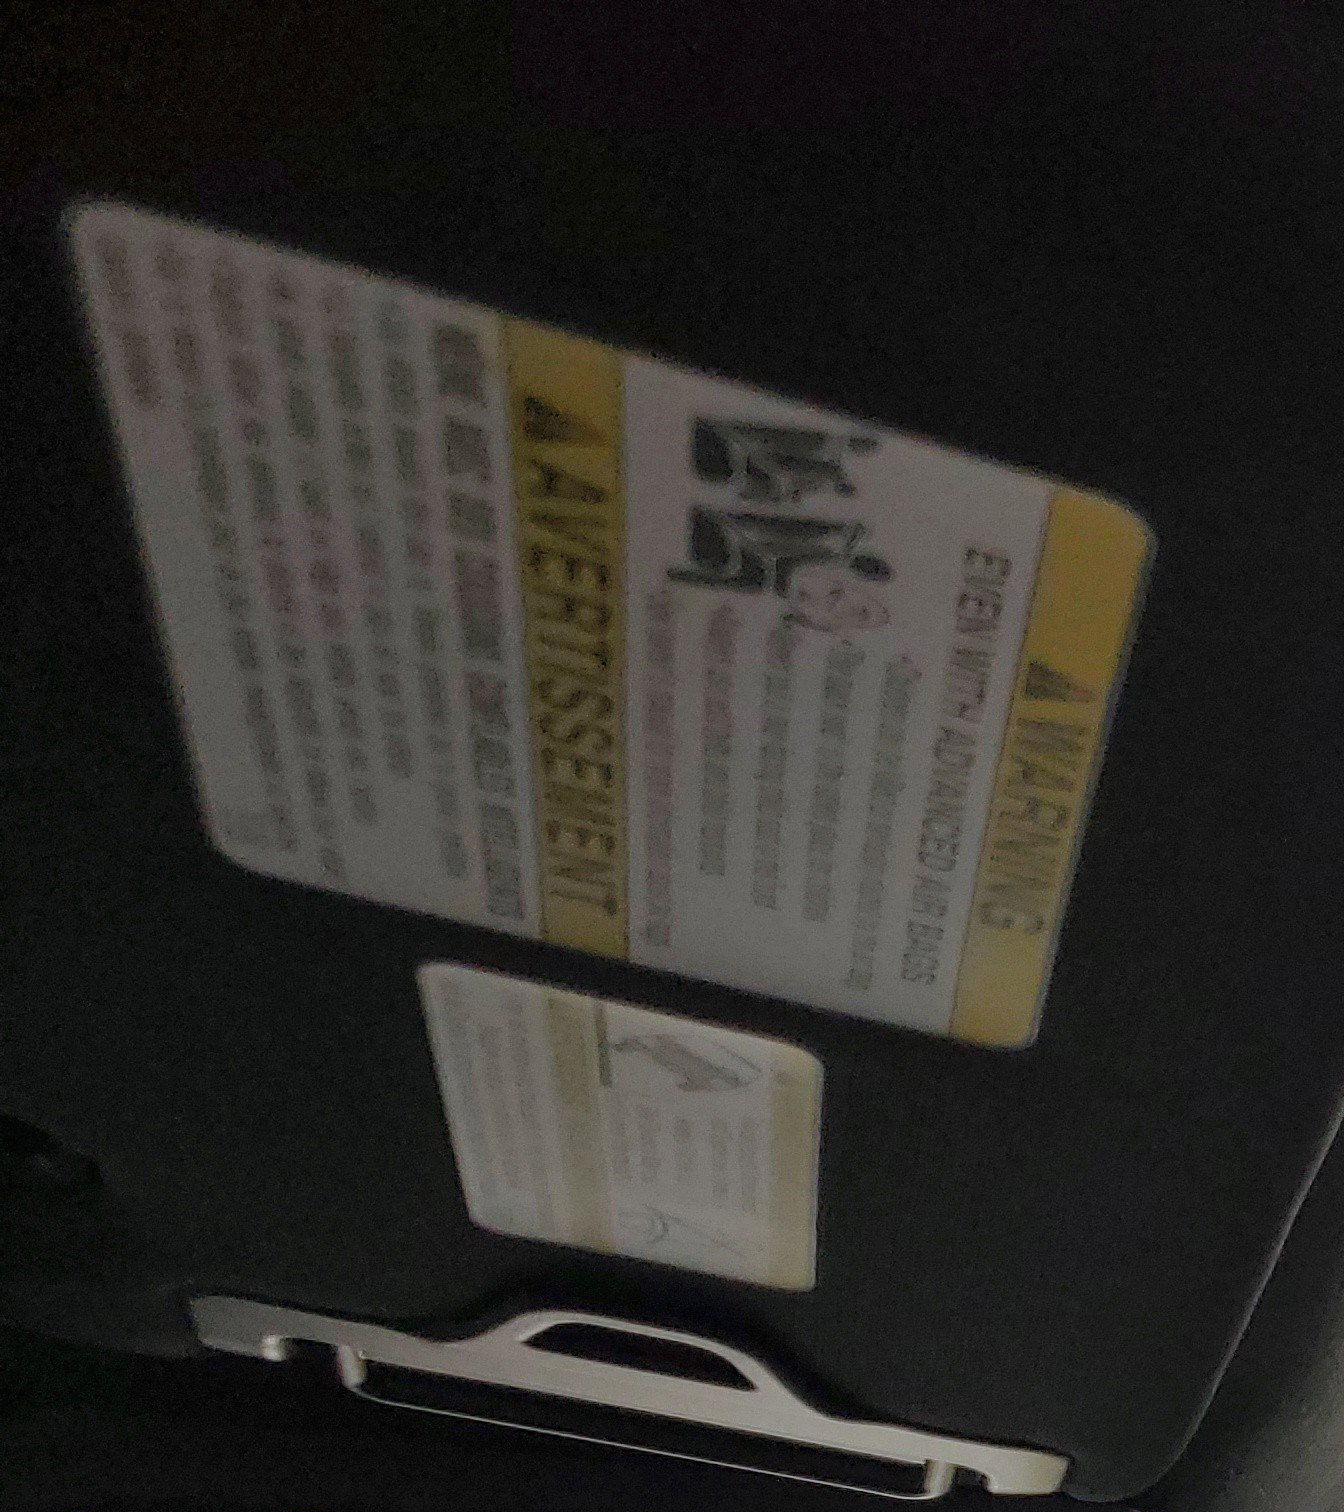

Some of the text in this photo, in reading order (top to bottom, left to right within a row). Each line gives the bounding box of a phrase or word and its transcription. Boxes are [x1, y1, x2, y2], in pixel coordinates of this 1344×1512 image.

[521, 454, 618, 919] AVERTISSEMENT
[898, 544, 1012, 987] EVEN WITH ADVANCED AIR BAGS
[977, 709, 1087, 939] WARNING
